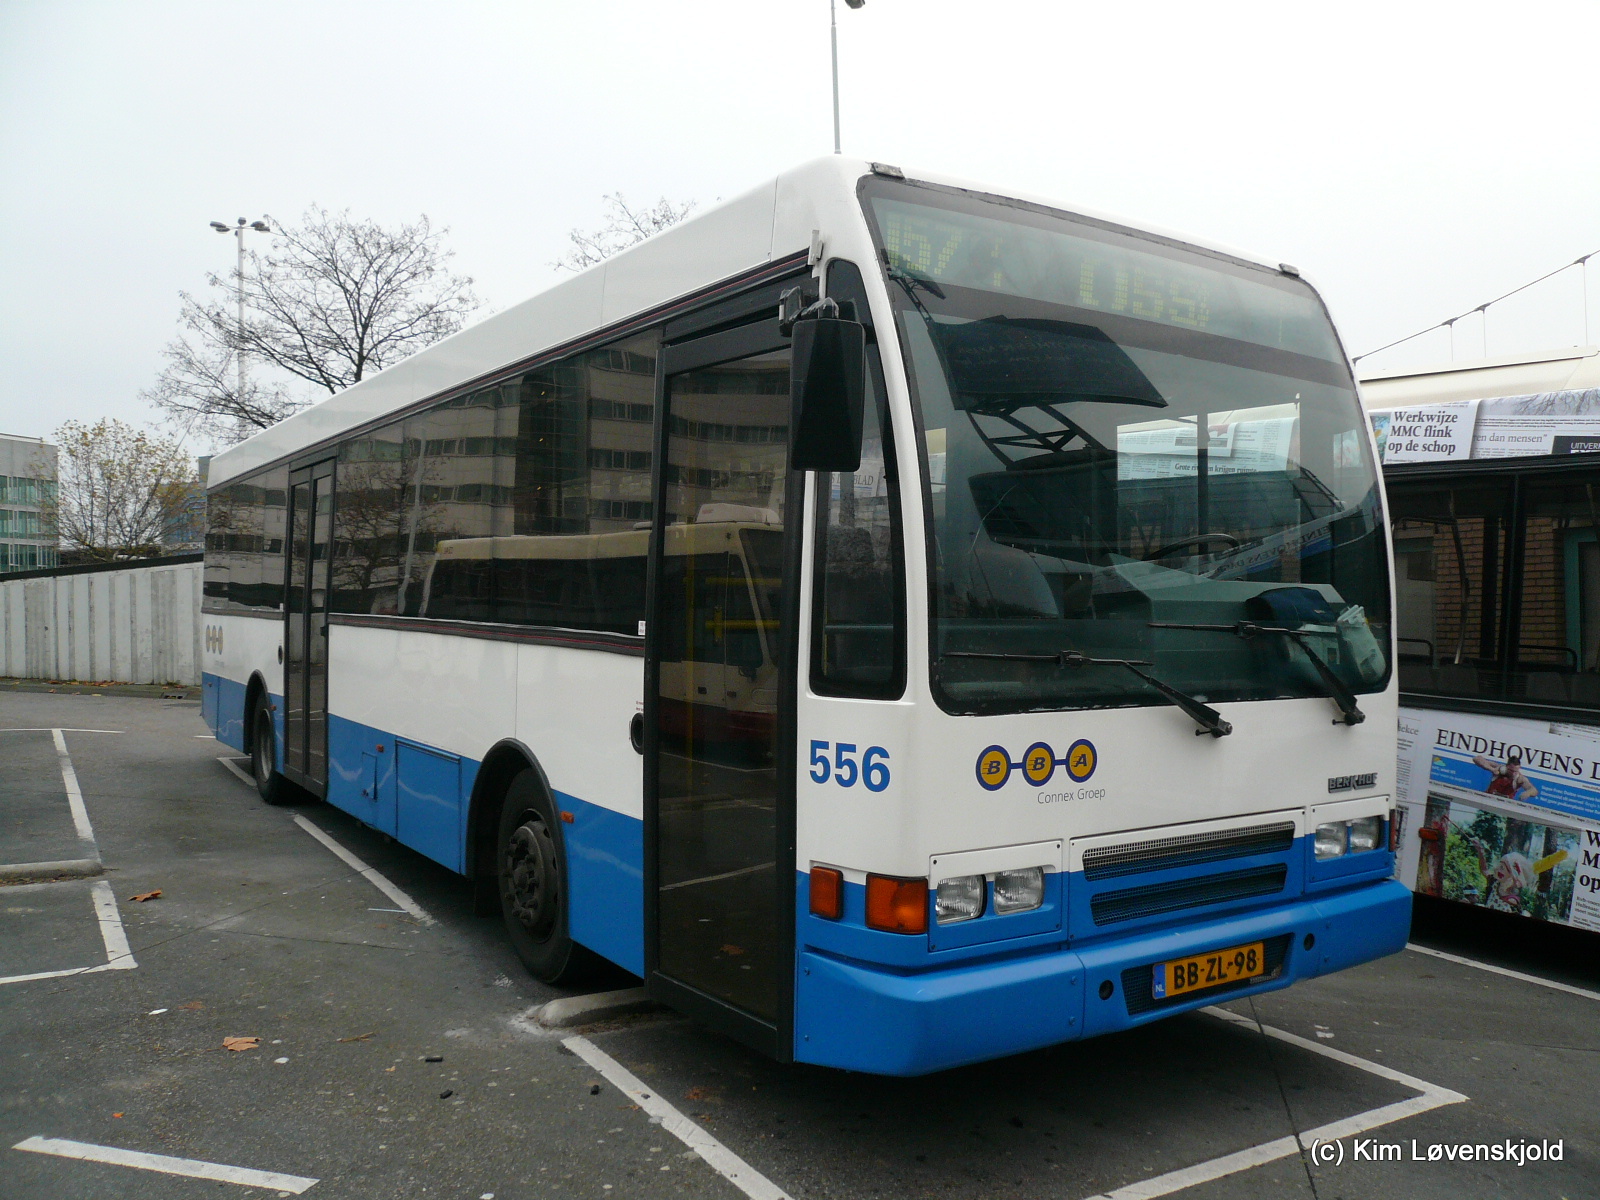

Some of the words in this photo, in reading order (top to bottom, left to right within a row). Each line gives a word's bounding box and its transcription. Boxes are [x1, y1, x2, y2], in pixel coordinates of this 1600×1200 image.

[1394, 410, 1458, 426] Werkwijze
[1390, 426, 1424, 437] MMC
[1423, 425, 1452, 438] flink
[1489, 432, 1505, 442] dan
[1388, 442, 1403, 454] op
[1405, 440, 1421, 452] de
[1422, 440, 1456, 455] schop
[1174, 462, 1191, 471] Grote
[1215, 465, 1236, 474] krijgen
[1435, 728, 1584, 776] EINDHOVENS
[809, 739, 891, 793] 556
[1328, 772, 1378, 792] BERKHOF
[1037, 791, 1075, 804] Connex
[1077, 788, 1106, 801] Groep
[1173, 948, 1258, 990] BB-ZL-98
[1155, 984, 1164, 993] NL
